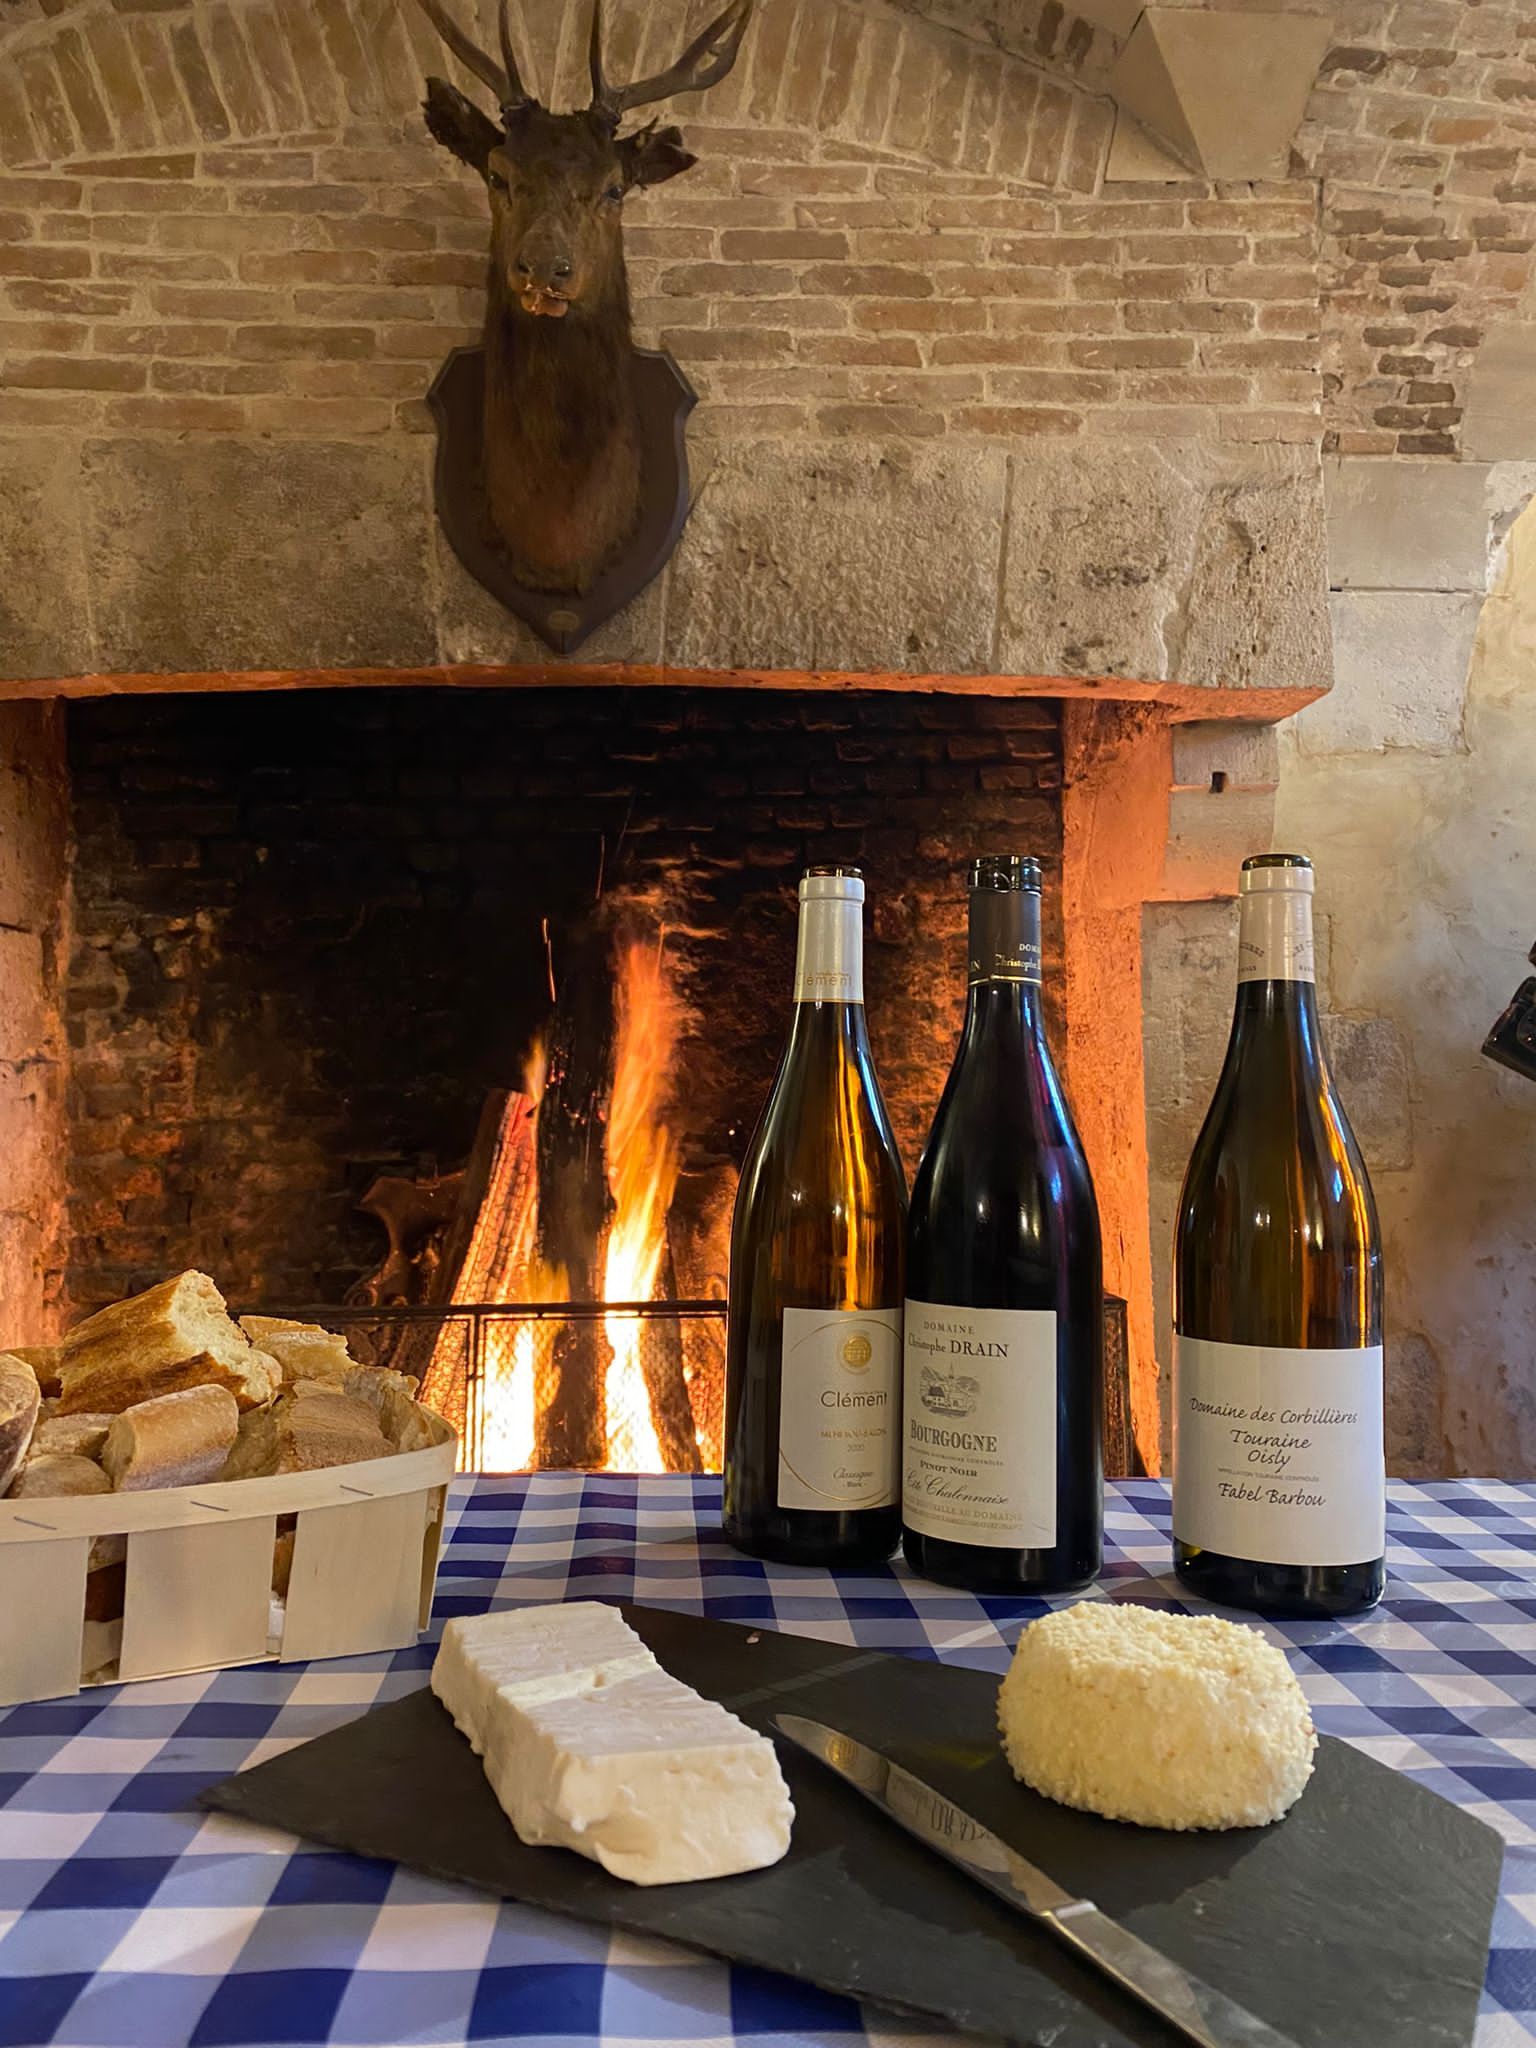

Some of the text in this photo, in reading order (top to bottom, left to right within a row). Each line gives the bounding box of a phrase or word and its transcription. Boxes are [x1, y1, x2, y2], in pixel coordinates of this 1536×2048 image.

[923, 1320, 976, 1335] DOMAINE
[950, 1339, 1010, 1358] DRAIN
[820, 1390, 888, 1408] Clément
[1190, 1397, 1358, 1424] Domaine des Corbillières
[910, 1418, 998, 1453] BOURGOGNE
[1230, 1428, 1312, 1449] Touraine
[1247, 1449, 1292, 1474] Oisly
[924, 1474, 1009, 1505] Chalonnaise
[1217, 1482, 1326, 1507] Fabel Barbou
